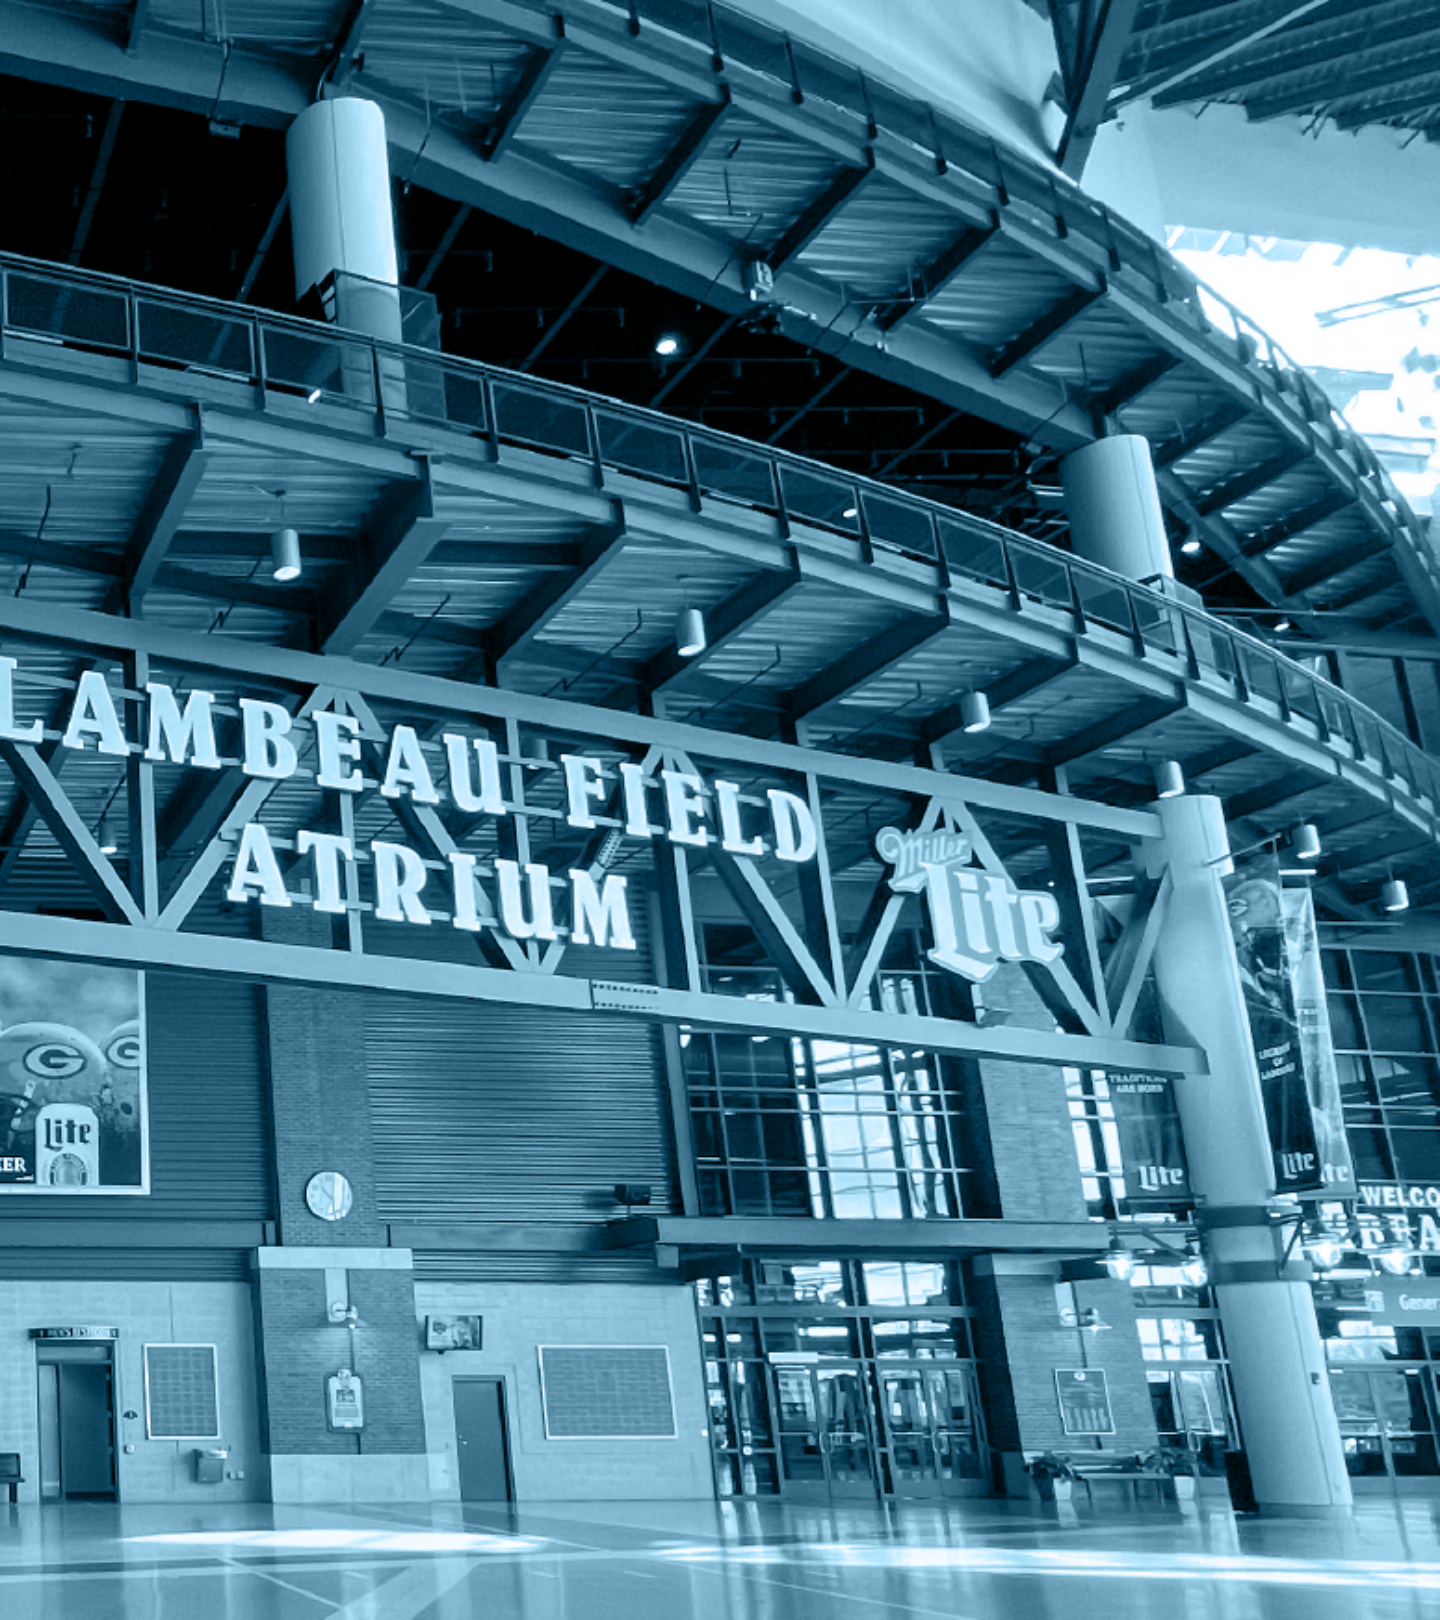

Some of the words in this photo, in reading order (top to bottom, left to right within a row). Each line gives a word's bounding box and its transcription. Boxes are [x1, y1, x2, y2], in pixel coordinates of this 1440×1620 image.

[560, 753, 818, 863] FIELD
[882, 833, 969, 879] Miller
[226, 823, 636, 950] ATRIUM
[919, 862, 1062, 978] Lite
[44, 1118, 92, 1152] Lite
[1138, 1165, 1184, 1192] Lite
[1281, 1152, 1316, 1180] Lite
[1360, 1185, 1440, 1207] WELCO
[1398, 1293, 1440, 1311] Gener
